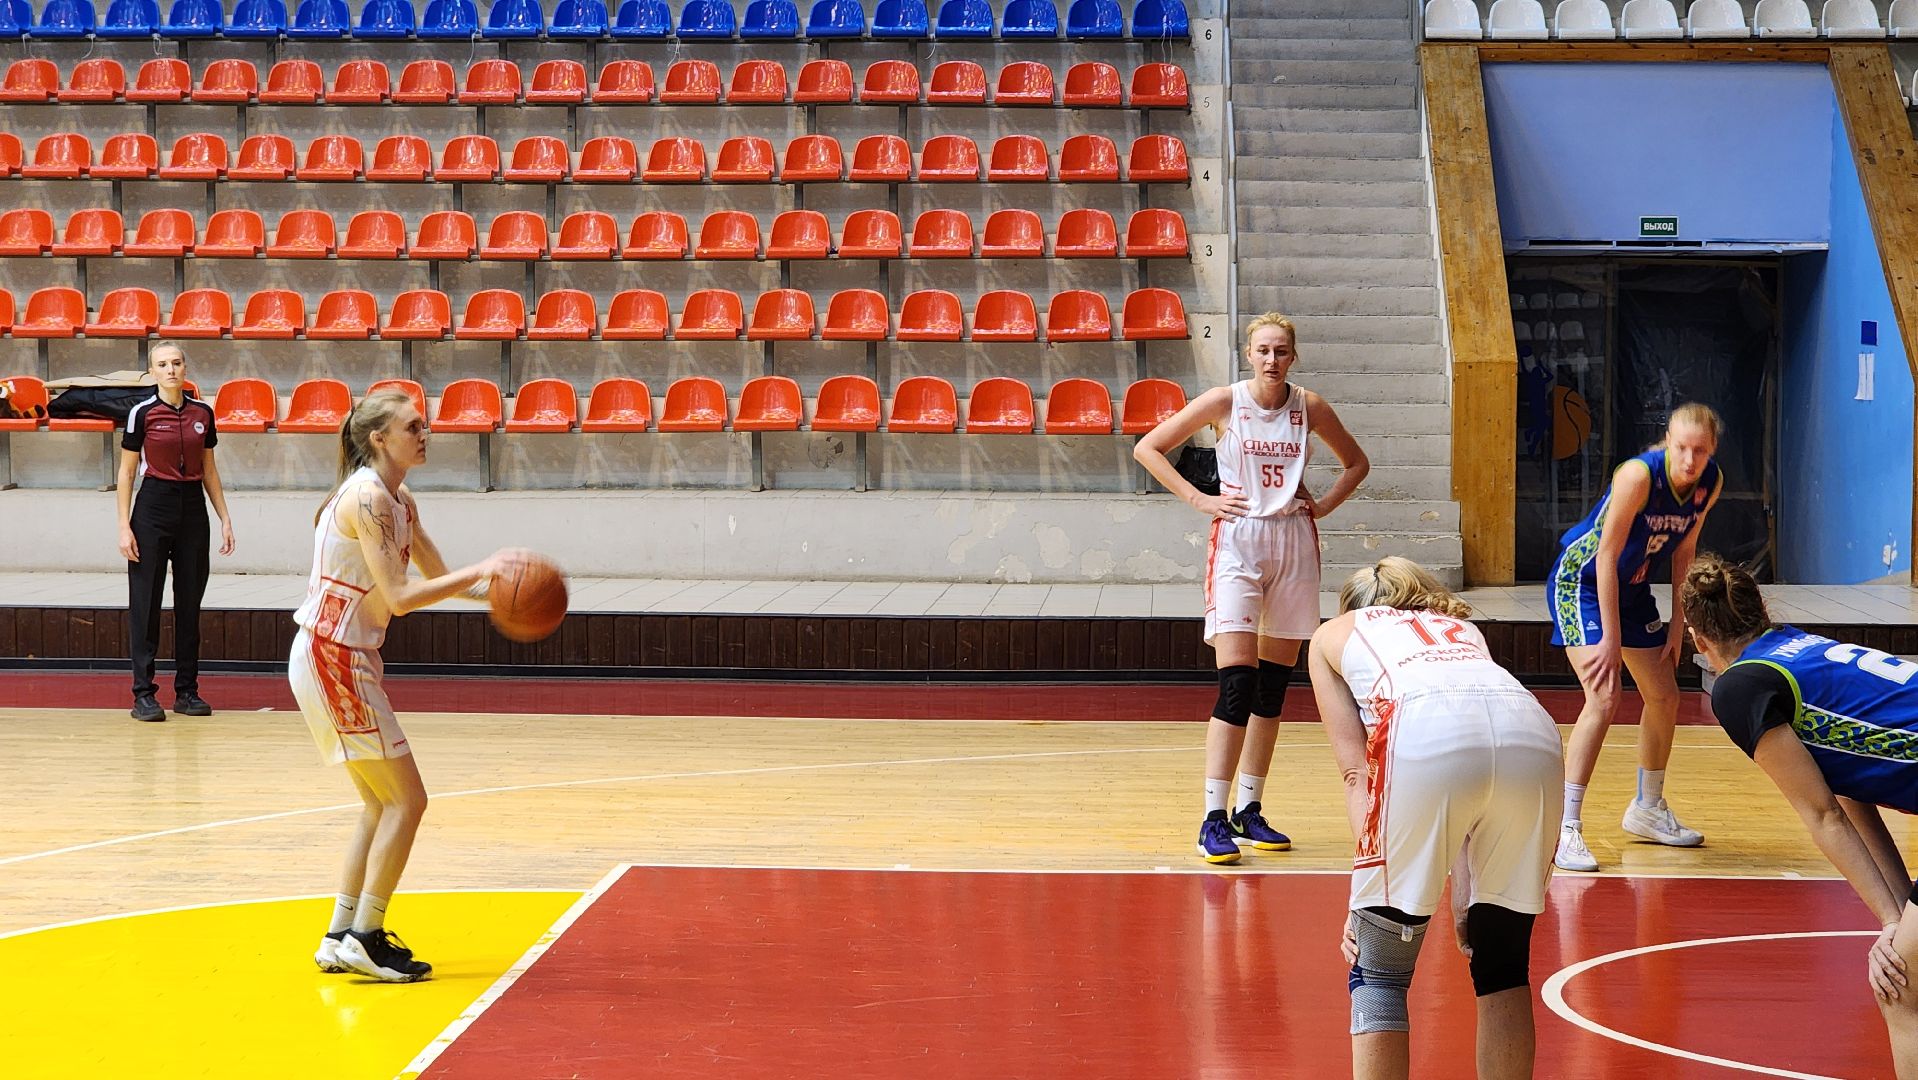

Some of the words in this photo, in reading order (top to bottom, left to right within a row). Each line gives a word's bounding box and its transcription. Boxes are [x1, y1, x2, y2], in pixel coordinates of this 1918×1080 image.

[1205, 29, 1212, 40] 6
[1203, 96, 1210, 108] 5
[1202, 170, 1210, 181] 4
[1643, 222, 1674, 231] ВЫХОД
[1205, 245, 1213, 257] 3
[1203, 326, 1212, 338] 2
[1243, 439, 1302, 453] СПАРТАК
[1262, 464, 1284, 488] 55
[1395, 618, 1480, 648] 12
[1824, 643, 1918, 685] 2
